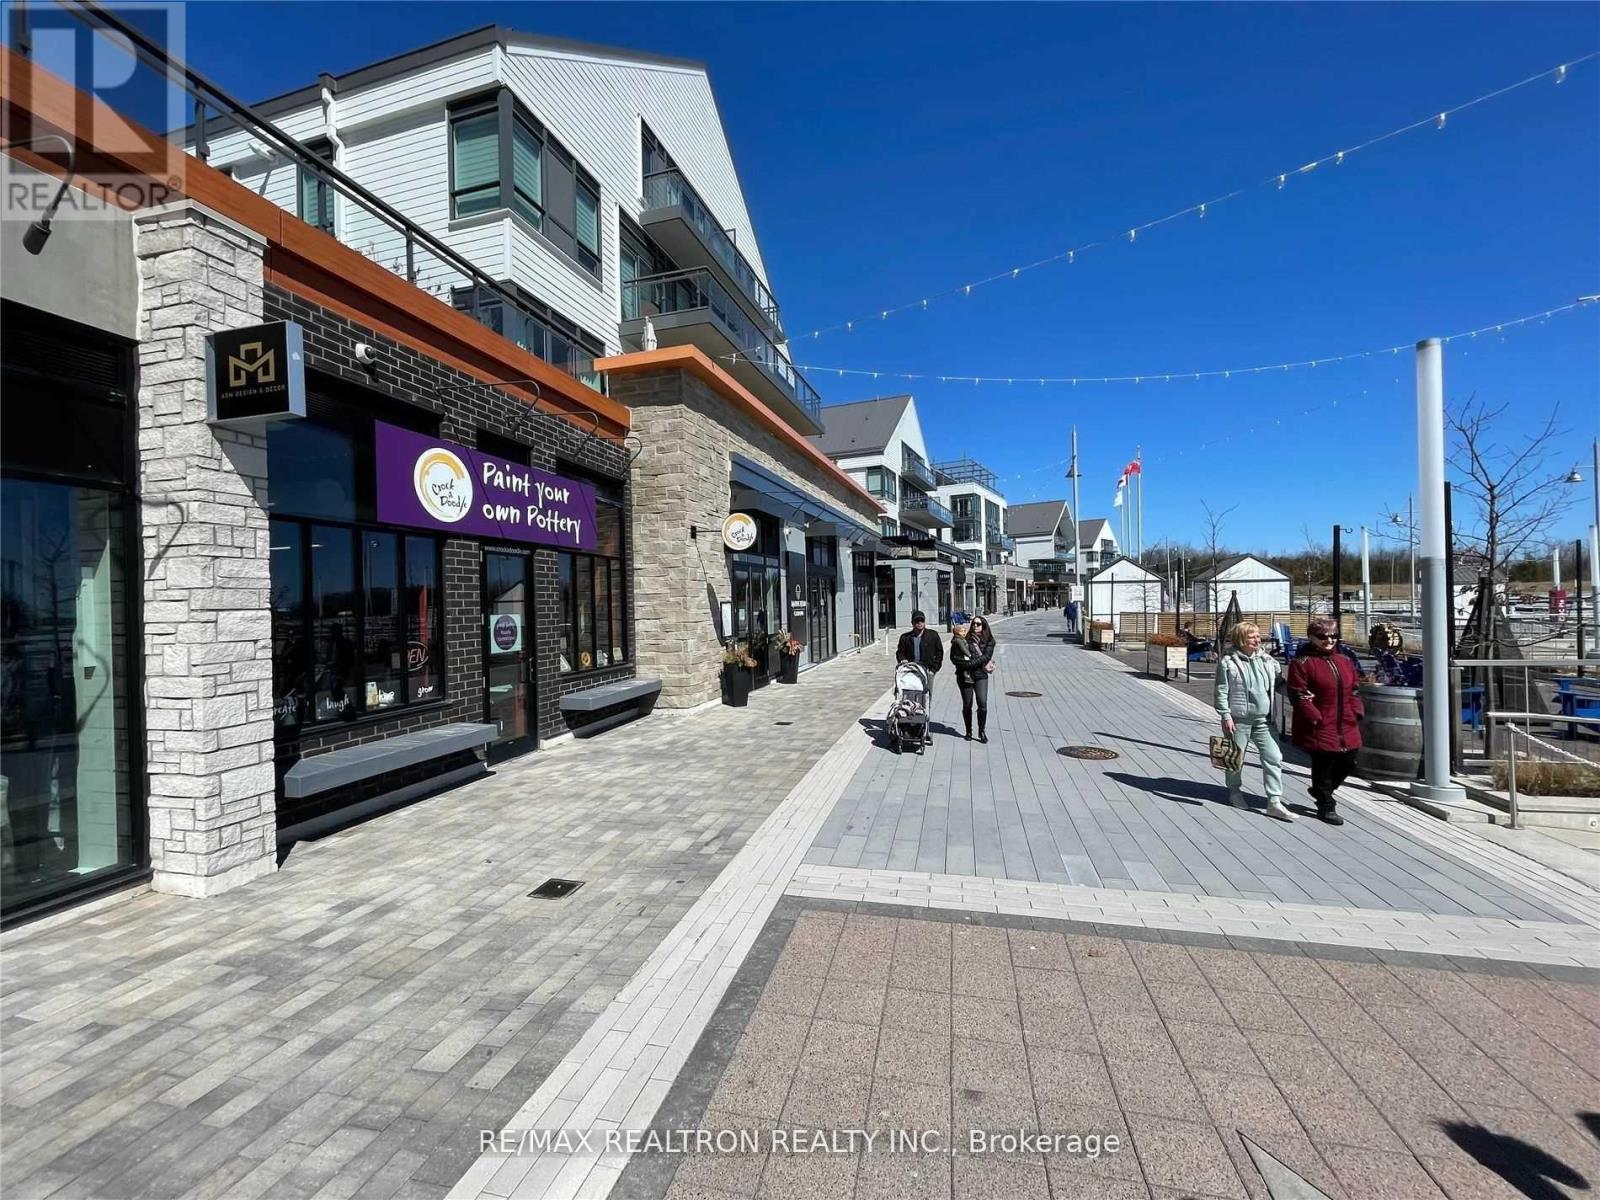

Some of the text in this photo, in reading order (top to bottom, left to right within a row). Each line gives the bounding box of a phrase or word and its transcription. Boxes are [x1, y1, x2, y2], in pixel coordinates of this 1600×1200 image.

[235, 387, 257, 397] DESIGN
[265, 384, 286, 393] DECOR
[432, 478, 455, 496] Crock
[483, 462, 570, 509] Paint your
[440, 495, 468, 513] Doodle
[482, 503, 582, 544] own Pottery
[417, 685, 434, 698] grow
[326, 693, 350, 712] laugh
